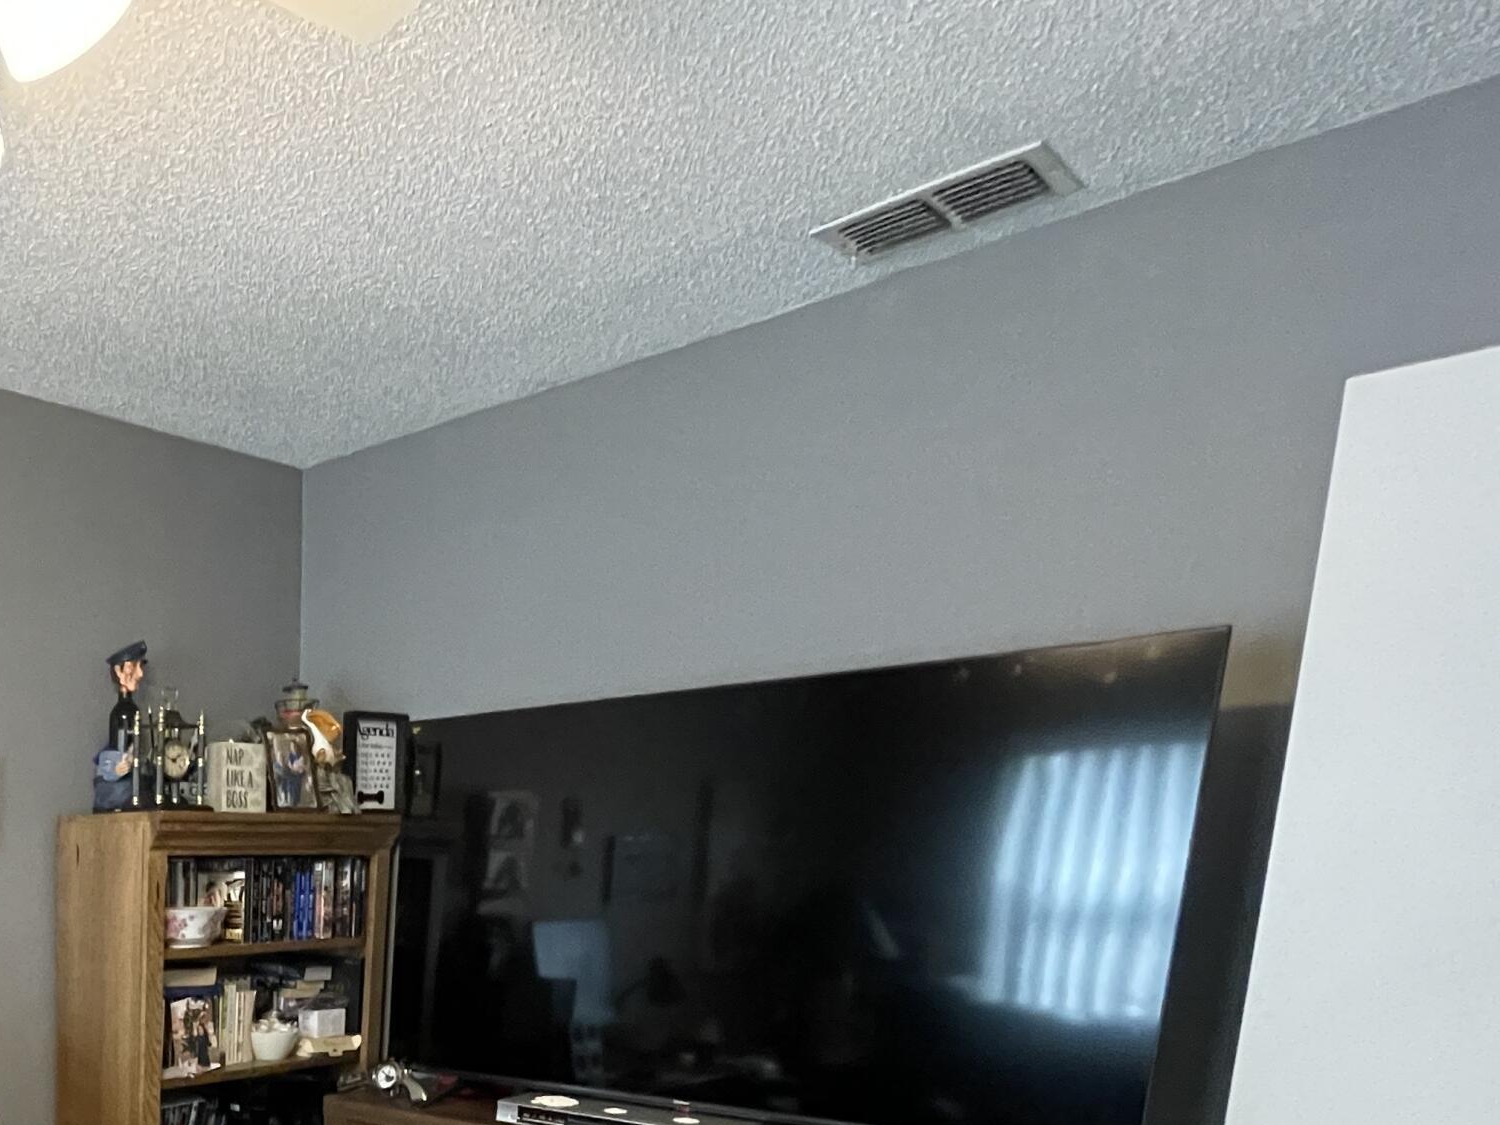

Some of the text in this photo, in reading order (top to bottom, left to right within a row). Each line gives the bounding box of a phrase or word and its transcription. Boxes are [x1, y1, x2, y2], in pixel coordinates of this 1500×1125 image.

[226, 747, 245, 766] NAP
[226, 768, 254, 789] LIKE A
[226, 789, 249, 809] BOSS
